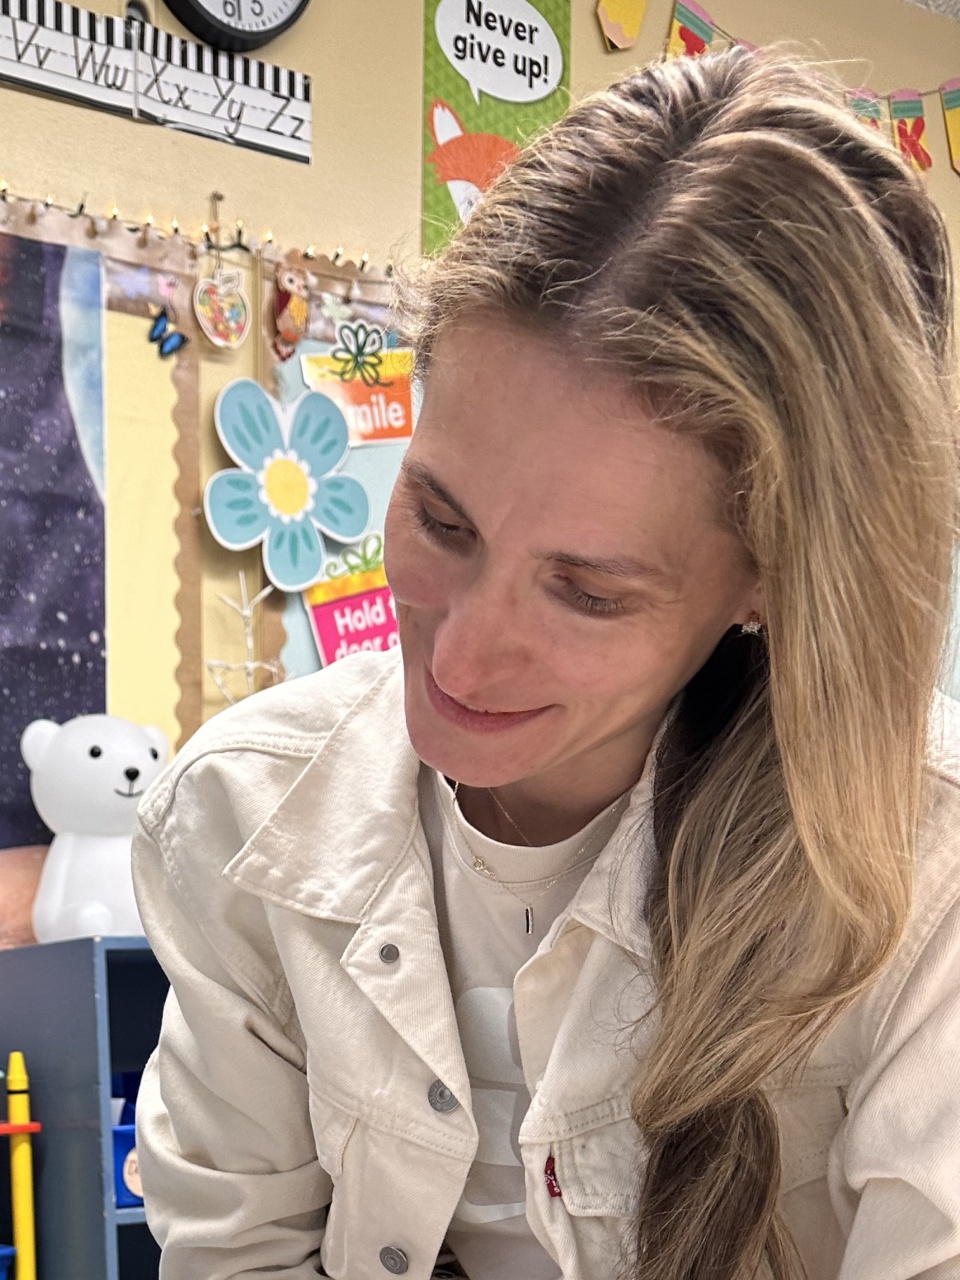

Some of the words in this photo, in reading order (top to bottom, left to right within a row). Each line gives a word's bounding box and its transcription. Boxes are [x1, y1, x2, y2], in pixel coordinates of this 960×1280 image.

[465, 0, 539, 44] Never
[11, 17, 53, 69] Vv
[74, 35, 129, 91] Ww
[143, 54, 192, 110] Xx
[211, 76, 246, 136] Yy
[272, 91, 306, 140] Zz
[453, 33, 506, 68] give
[513, 53, 549, 89] up!
[346, 393, 405, 435] mile
[333, 595, 386, 636] Hold
